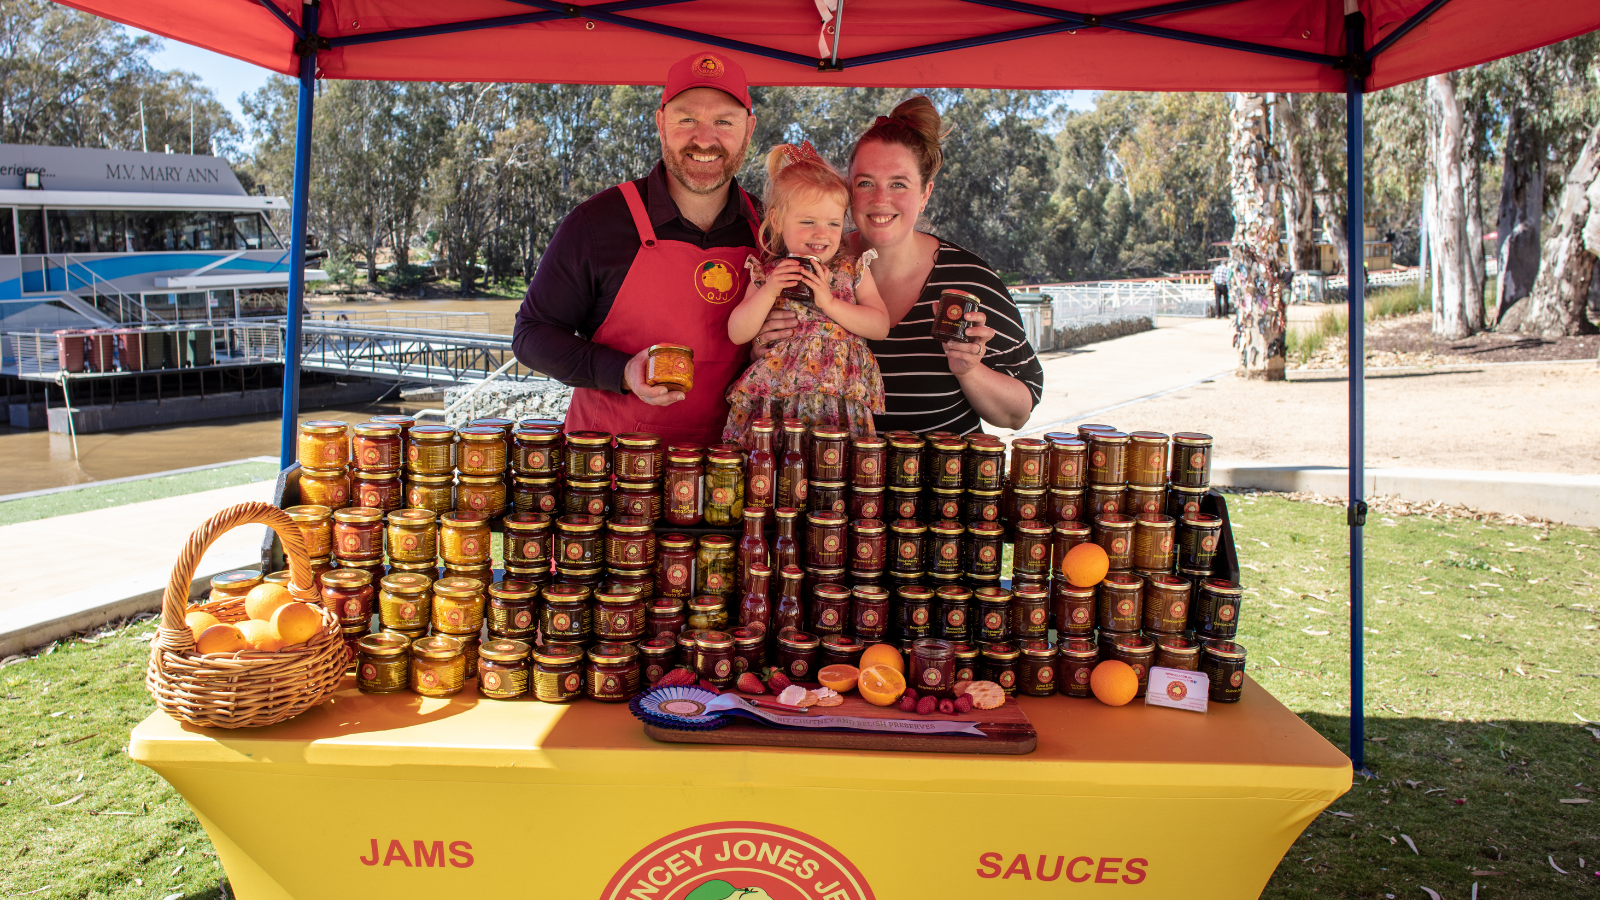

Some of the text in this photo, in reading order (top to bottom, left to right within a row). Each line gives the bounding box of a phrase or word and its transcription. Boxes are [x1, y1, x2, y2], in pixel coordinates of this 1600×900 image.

[106, 163, 219, 183] M.V. MARY ANN
[792, 717, 834, 725] CHUTNEY
[836, 717, 855, 725] AND
[857, 720, 887, 728] RELISH
[888, 721, 936, 730] PRESERVES
[360, 838, 475, 868] JAMS
[714, 840, 820, 880] JONES
[976, 851, 1149, 885] SAUCES
